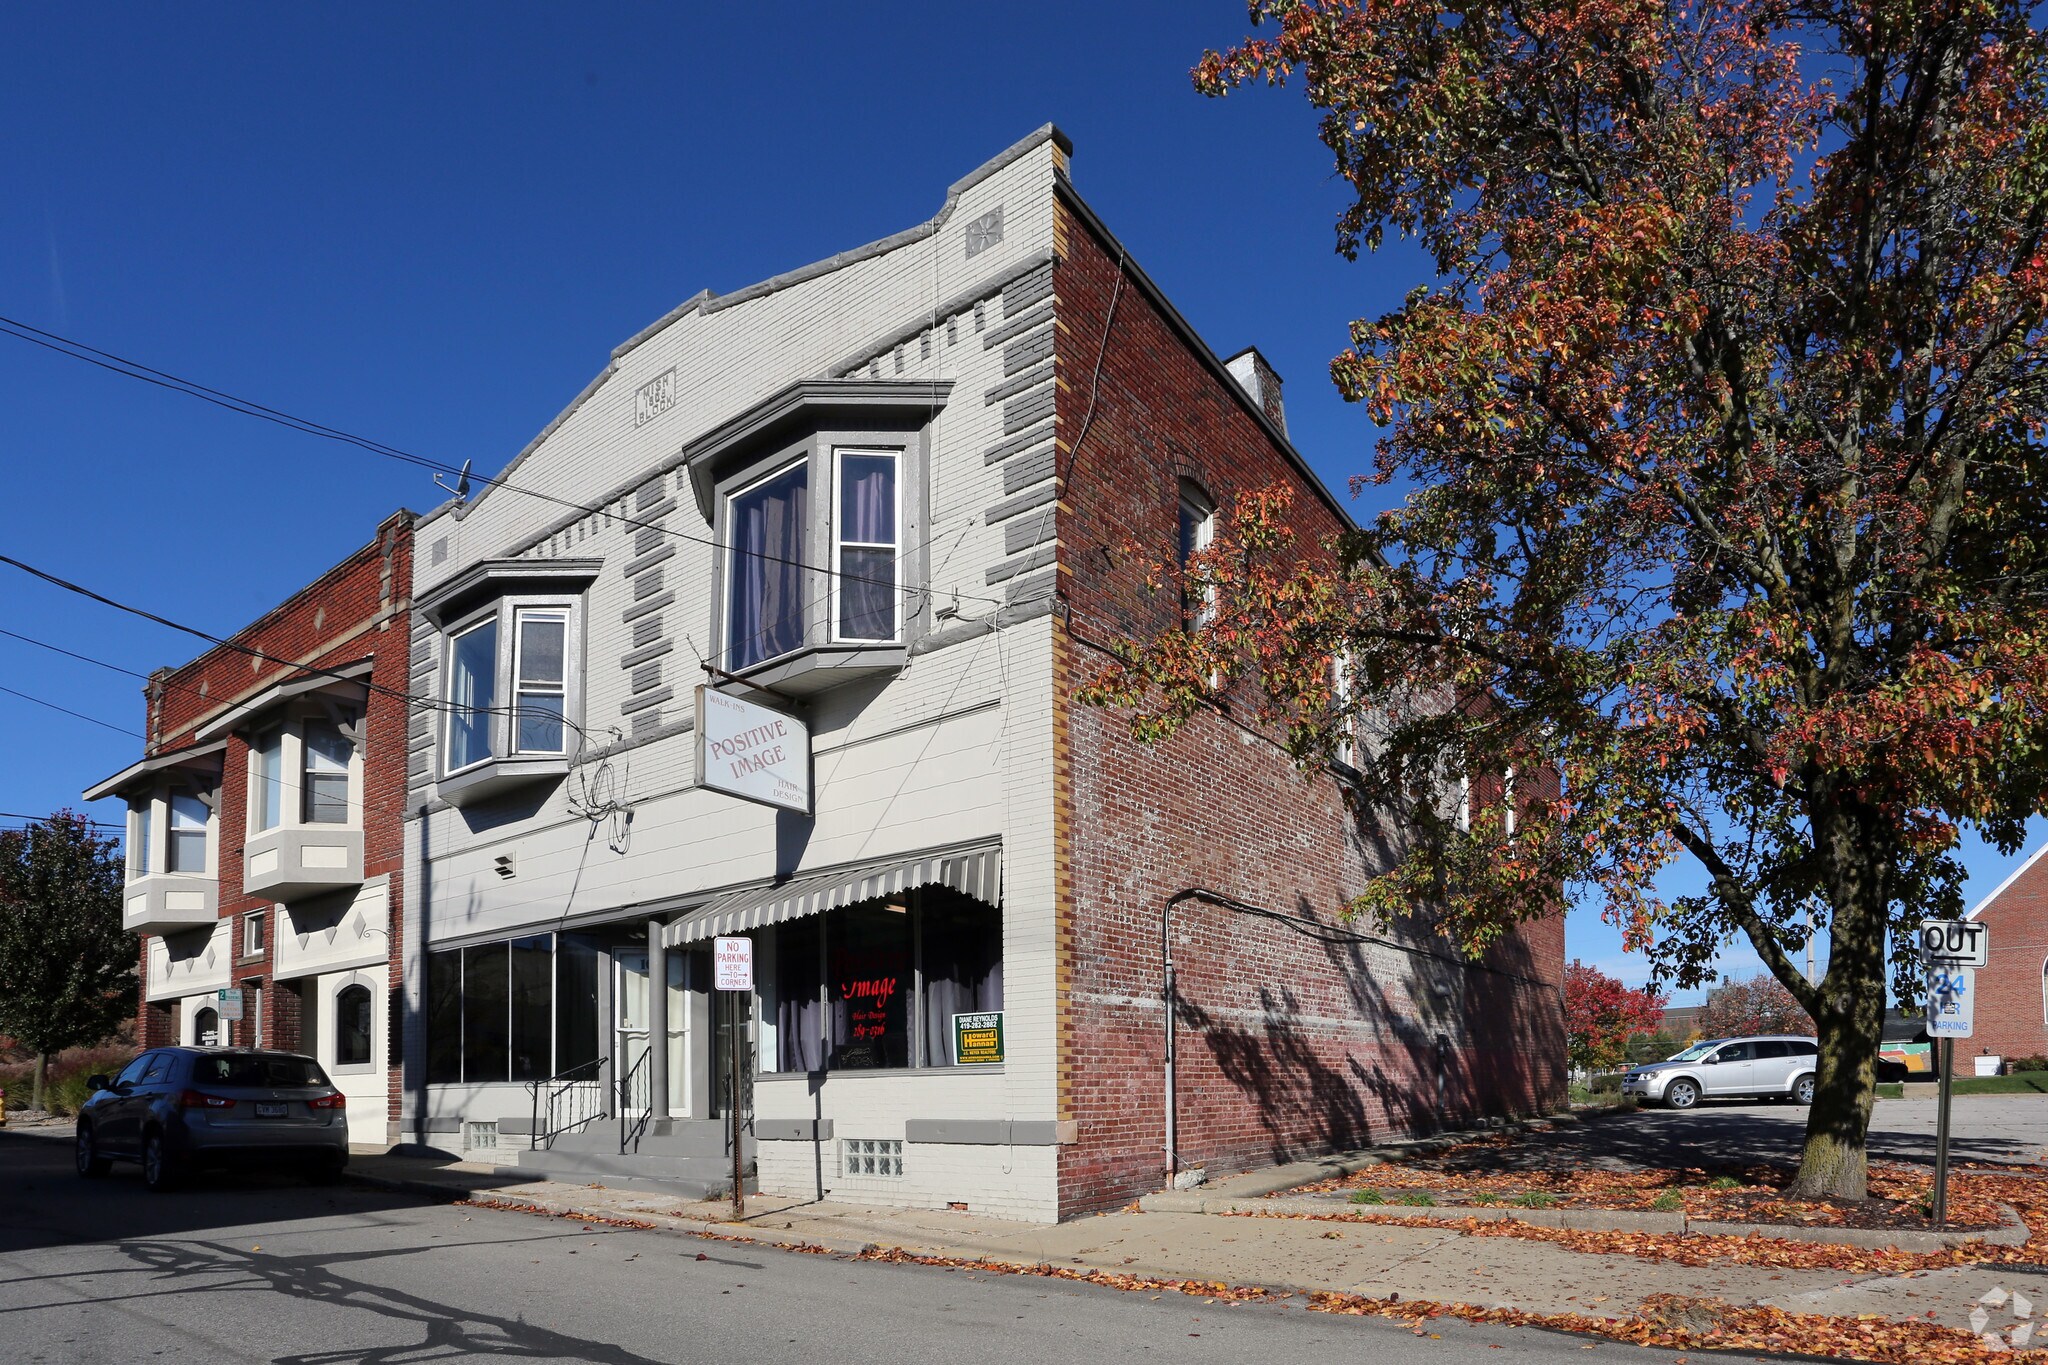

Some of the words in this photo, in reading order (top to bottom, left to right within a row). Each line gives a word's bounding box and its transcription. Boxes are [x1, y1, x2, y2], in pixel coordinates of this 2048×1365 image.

[643, 374, 669, 400] MISH
[639, 394, 673, 424] BLOCK
[709, 694, 746, 713] WALK-INS
[710, 719, 788, 761] POSITIVE
[730, 744, 786, 780] IMAGE
[777, 778, 799, 792] HAIR
[773, 788, 803, 803] DESIGN
[726, 942, 740, 952] NO
[1925, 926, 1983, 953] OUT
[717, 952, 749, 963] PARKING
[730, 971, 738, 979] TO
[1936, 973, 1966, 995] 24
[219, 990, 225, 1000] 2
[841, 977, 896, 1009] Image
[959, 1015, 973, 1024] DIANE
[973, 1014, 998, 1022] REYNOLDS
[1932, 1020, 1968, 1031] PARKING
